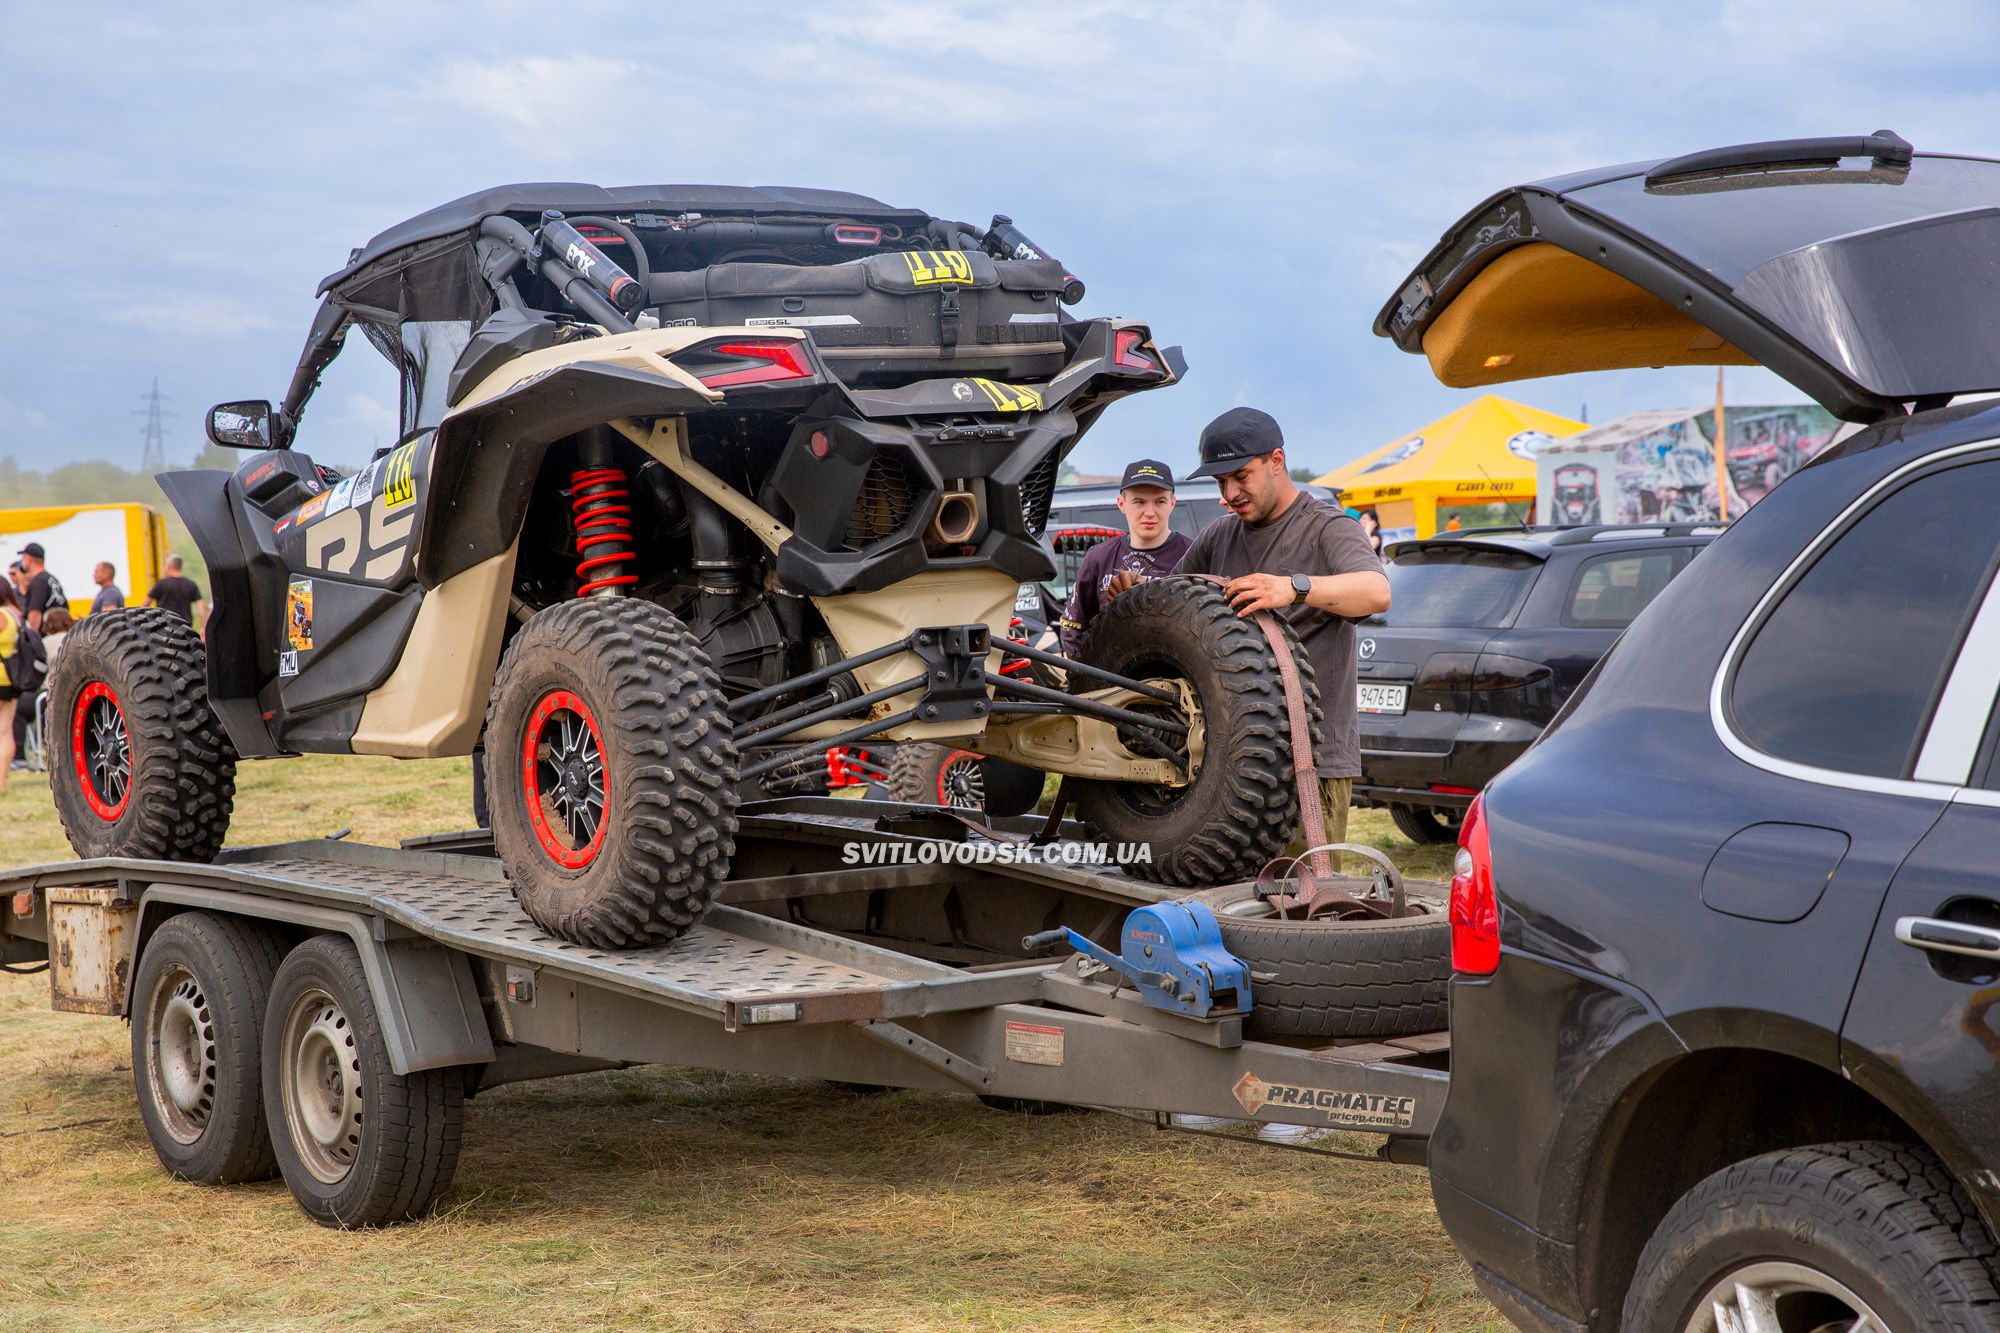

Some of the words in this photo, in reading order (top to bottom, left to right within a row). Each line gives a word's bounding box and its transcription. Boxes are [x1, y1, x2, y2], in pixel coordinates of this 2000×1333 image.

[566, 243, 596, 279] FOX
[306, 478, 417, 580] RS
[1360, 687, 1385, 706] 9476
[1386, 688, 1403, 706] EO
[1267, 1085, 1413, 1115] PRAGMATEC
